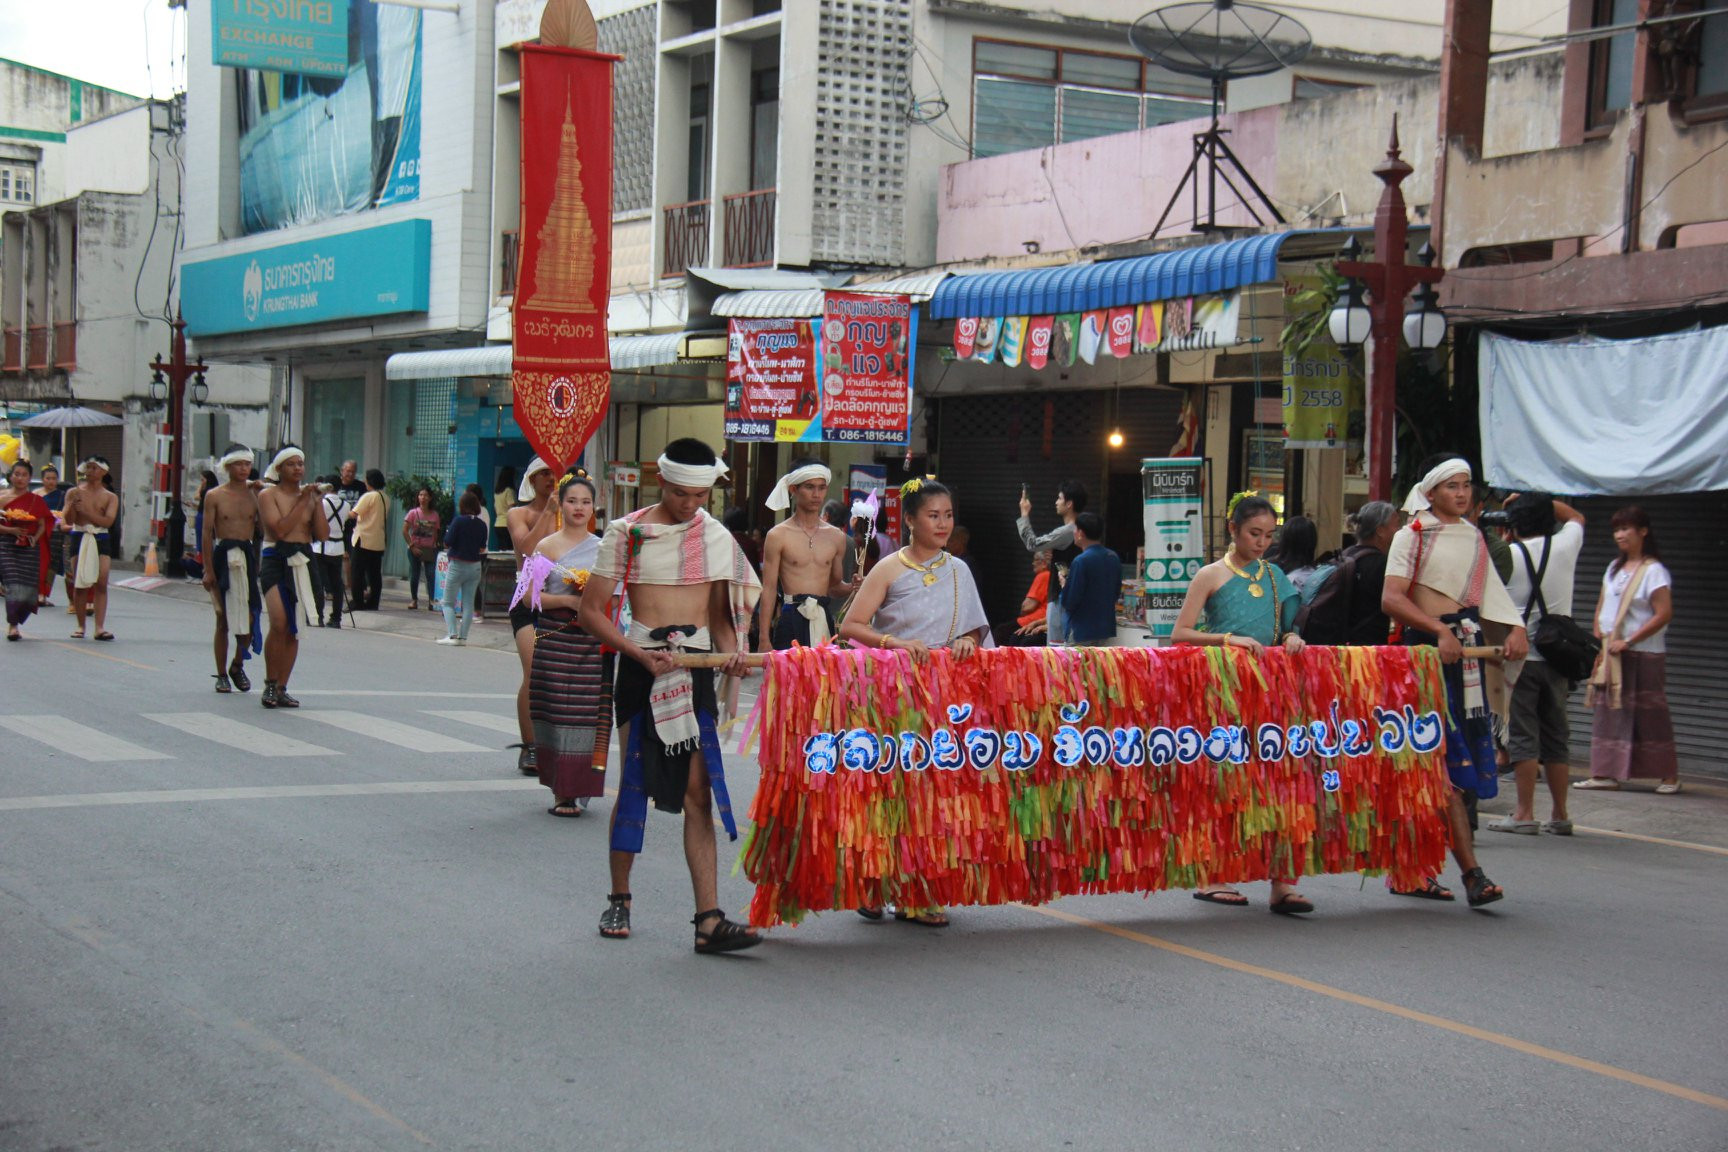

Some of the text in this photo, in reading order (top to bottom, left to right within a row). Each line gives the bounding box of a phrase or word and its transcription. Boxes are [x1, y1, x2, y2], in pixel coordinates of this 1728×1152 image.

[221, 26, 314, 50] EXCHANGE
[301, 57, 346, 73] UPDATE
[264, 253, 335, 291] ธนาคารกรุงไทย
[263, 291, 319, 314] KRUNGTHAI BANK
[756, 333, 798, 355] กุญแจ
[852, 353, 881, 375] แจ
[1301, 390, 1344, 407] 2558
[825, 429, 904, 442] T. 086-1816446
